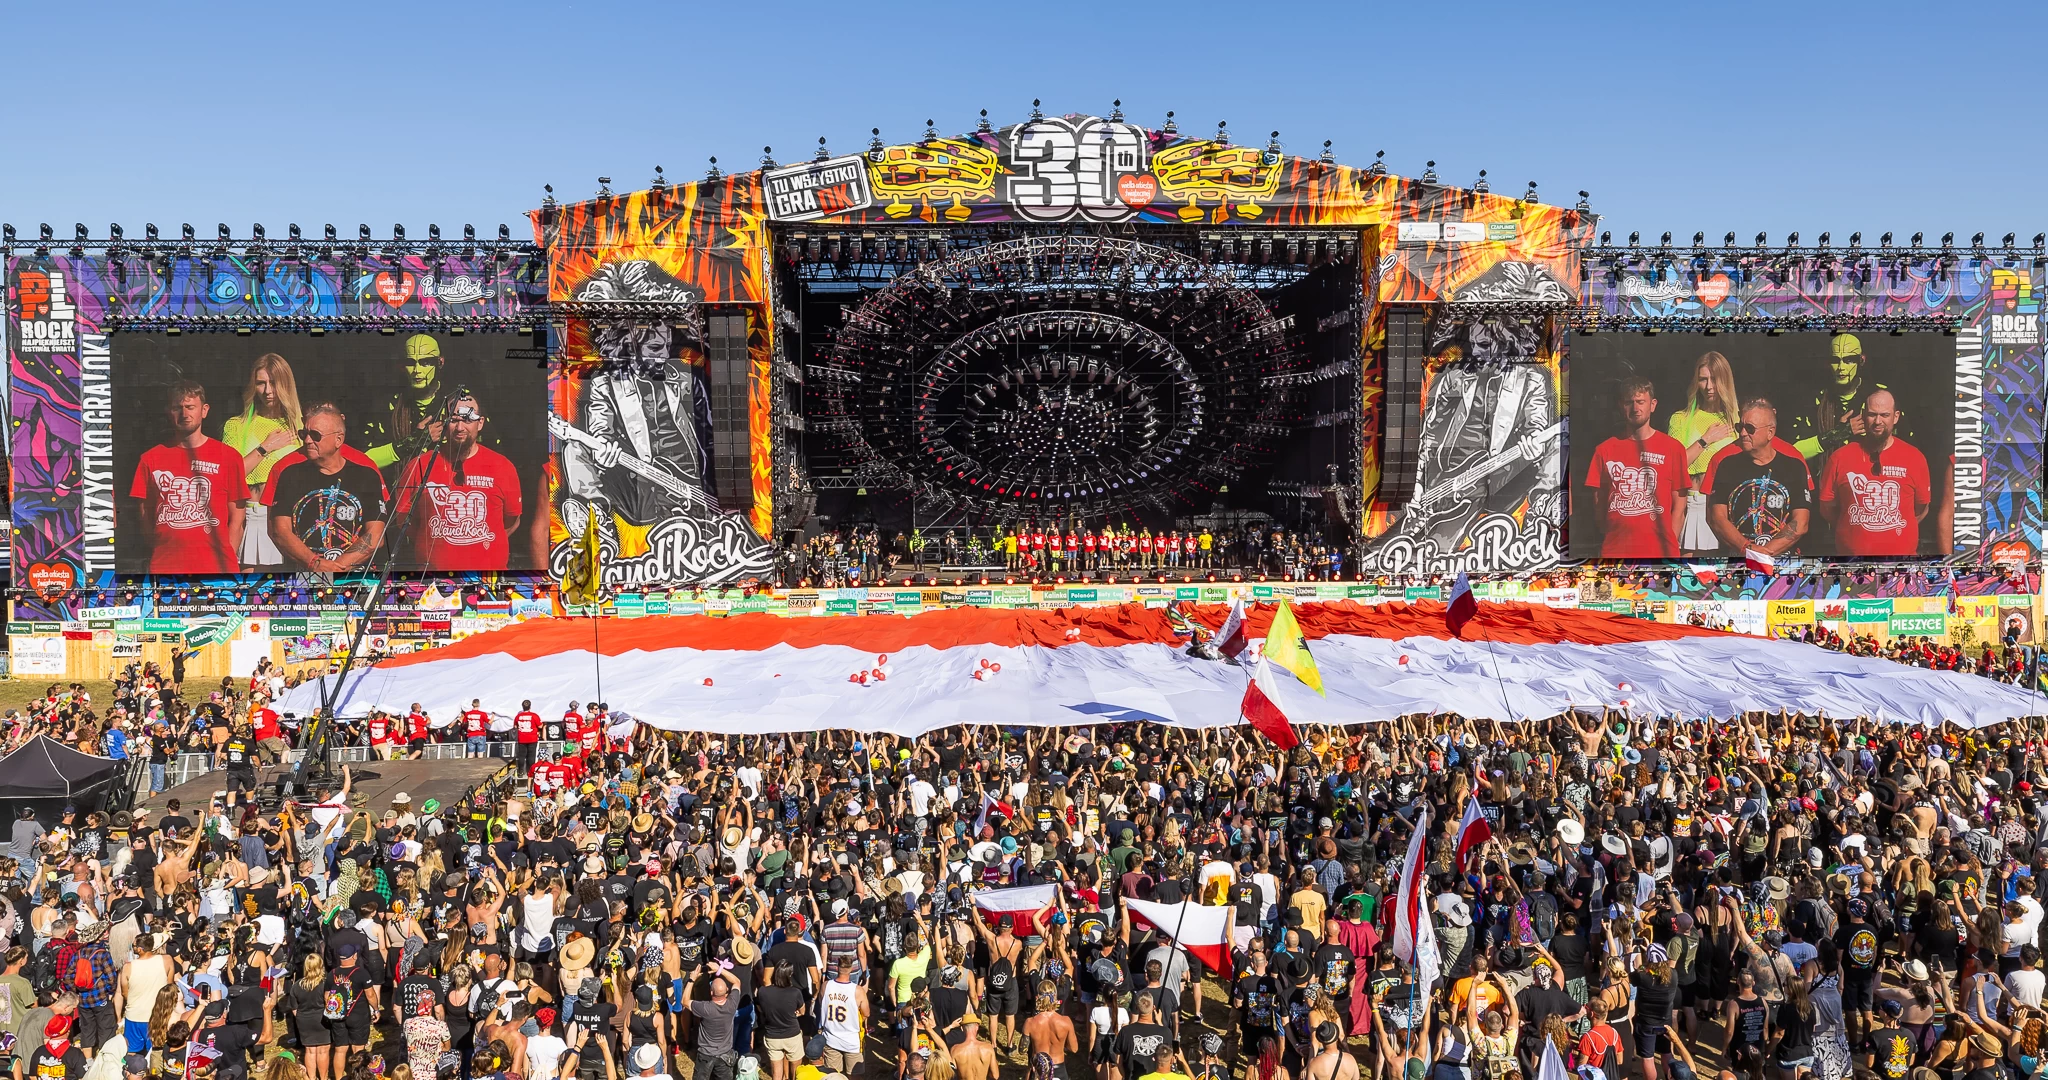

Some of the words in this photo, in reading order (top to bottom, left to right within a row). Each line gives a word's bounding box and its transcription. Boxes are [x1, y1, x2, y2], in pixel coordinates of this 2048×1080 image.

[1015, 123, 1137, 219] 30
[1117, 150, 1134, 168] th
[771, 178, 790, 194] TU
[790, 164, 858, 191] WSZYSTKO
[776, 192, 818, 216] GRA
[20, 321, 75, 339] ROCK
[1991, 315, 2039, 332] ROCK
[1620, 467, 1657, 498] 30
[170, 477, 210, 509] 30
[1863, 481, 1899, 513] 30
[446, 491, 486, 525] 30
[32, 570, 49, 580] wielka
[994, 596, 1028, 604] Kłobuck
[1071, 591, 1095, 599] Polanów
[1409, 590, 1437, 598] Hajnówka
[2003, 596, 2028, 605] Iława
[731, 600, 766, 609] Nowina
[1776, 605, 1806, 615] Altena
[82, 606, 137, 618] BIŁGORAJ
[424, 613, 448, 621] WAŁCZ
[1850, 607, 1891, 617] Szydłowo
[213, 614, 242, 643] Toruń
[271, 624, 306, 632] Gniezno
[1891, 617, 1943, 631] PIESZYCE
[189, 628, 218, 645] Kościan
[828, 993, 849, 1003] GASOL
[827, 1004, 847, 1023] 16
